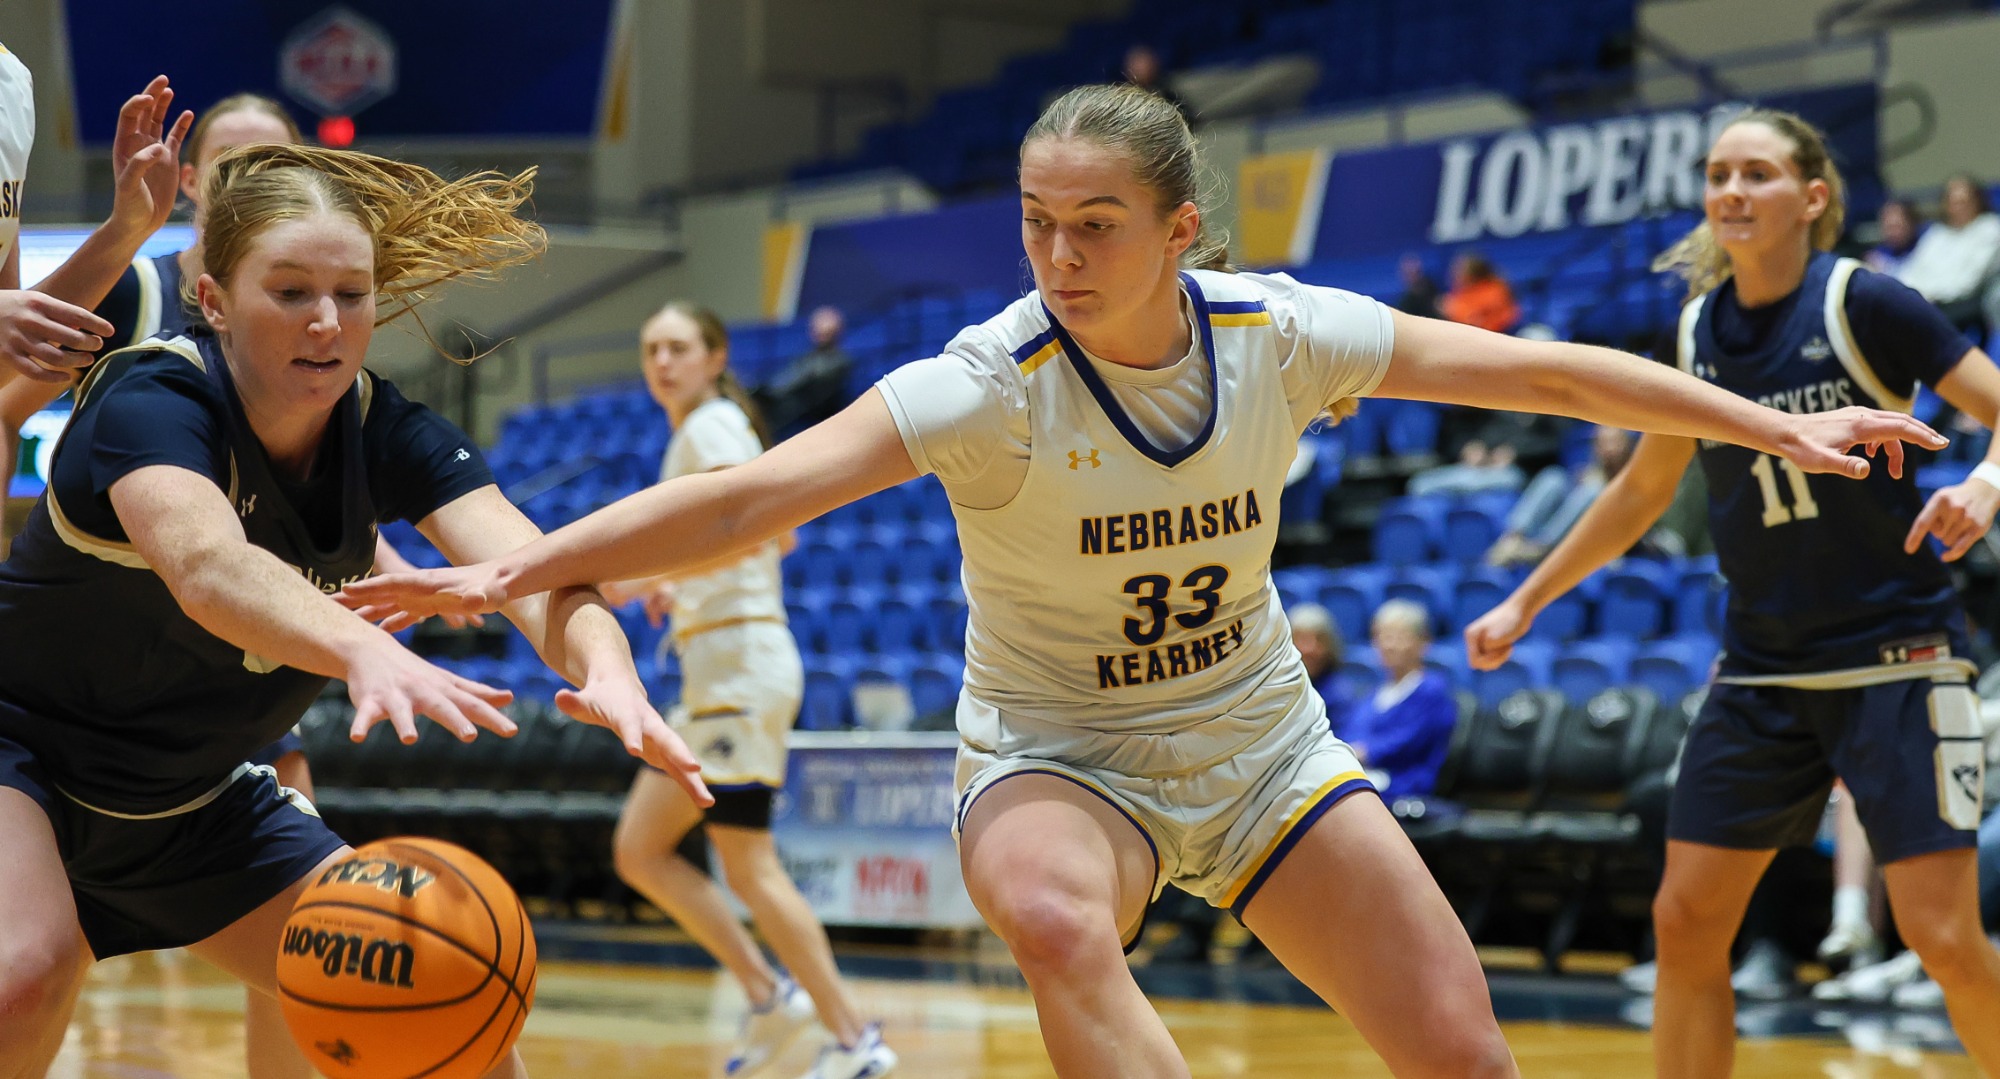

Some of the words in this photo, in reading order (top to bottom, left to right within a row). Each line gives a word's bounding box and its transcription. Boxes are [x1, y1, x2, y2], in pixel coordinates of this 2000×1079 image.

[1431, 103, 1752, 243] LOPER
[1079, 487, 1262, 556] NEBRASKA
[1751, 452, 1819, 528] 11
[1120, 561, 1232, 648] 33
[1096, 617, 1244, 690] KEARNEY
[283, 924, 415, 989] Wilson
